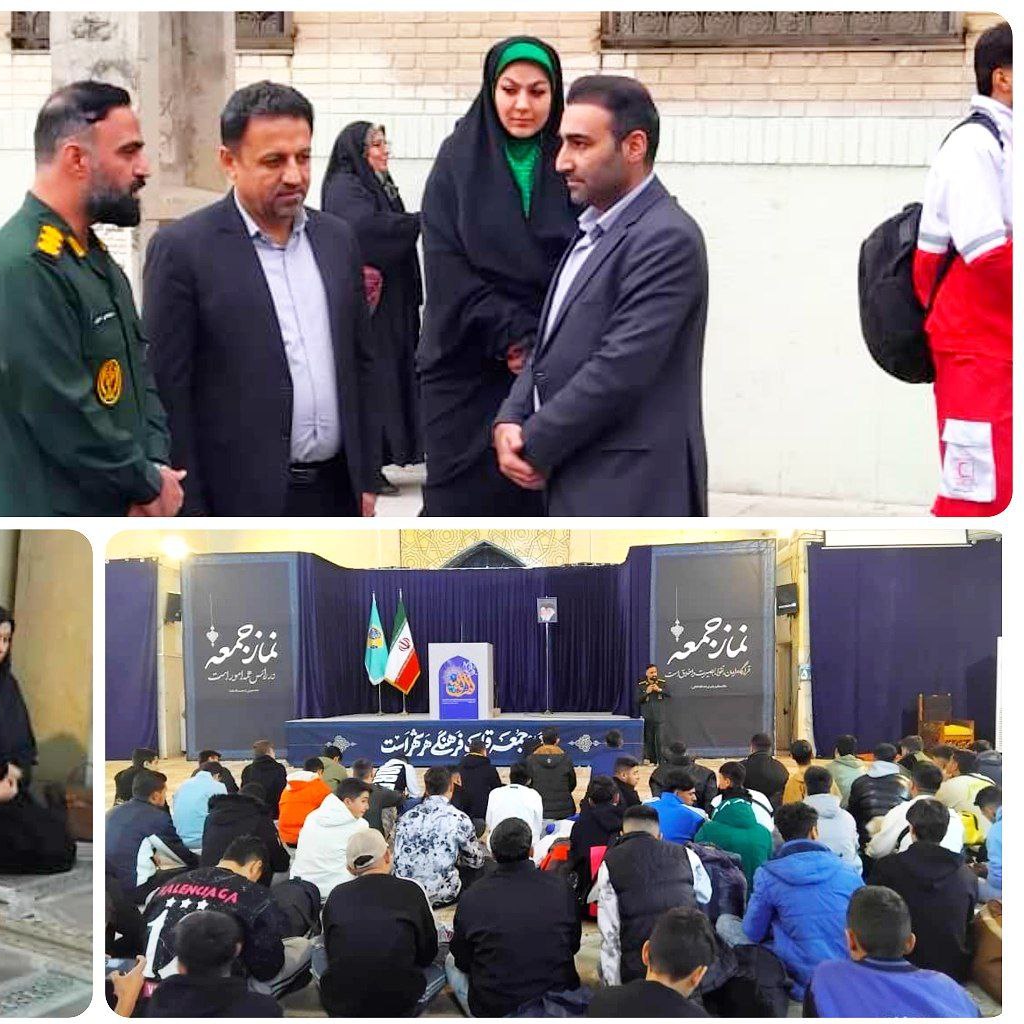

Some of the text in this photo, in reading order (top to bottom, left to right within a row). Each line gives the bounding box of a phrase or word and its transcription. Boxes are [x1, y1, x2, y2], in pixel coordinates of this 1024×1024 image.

[204, 624, 278, 670] نماز جمعه
[666, 617, 748, 665] نماز جمعه
[430, 730, 464, 757] فرهنگی
